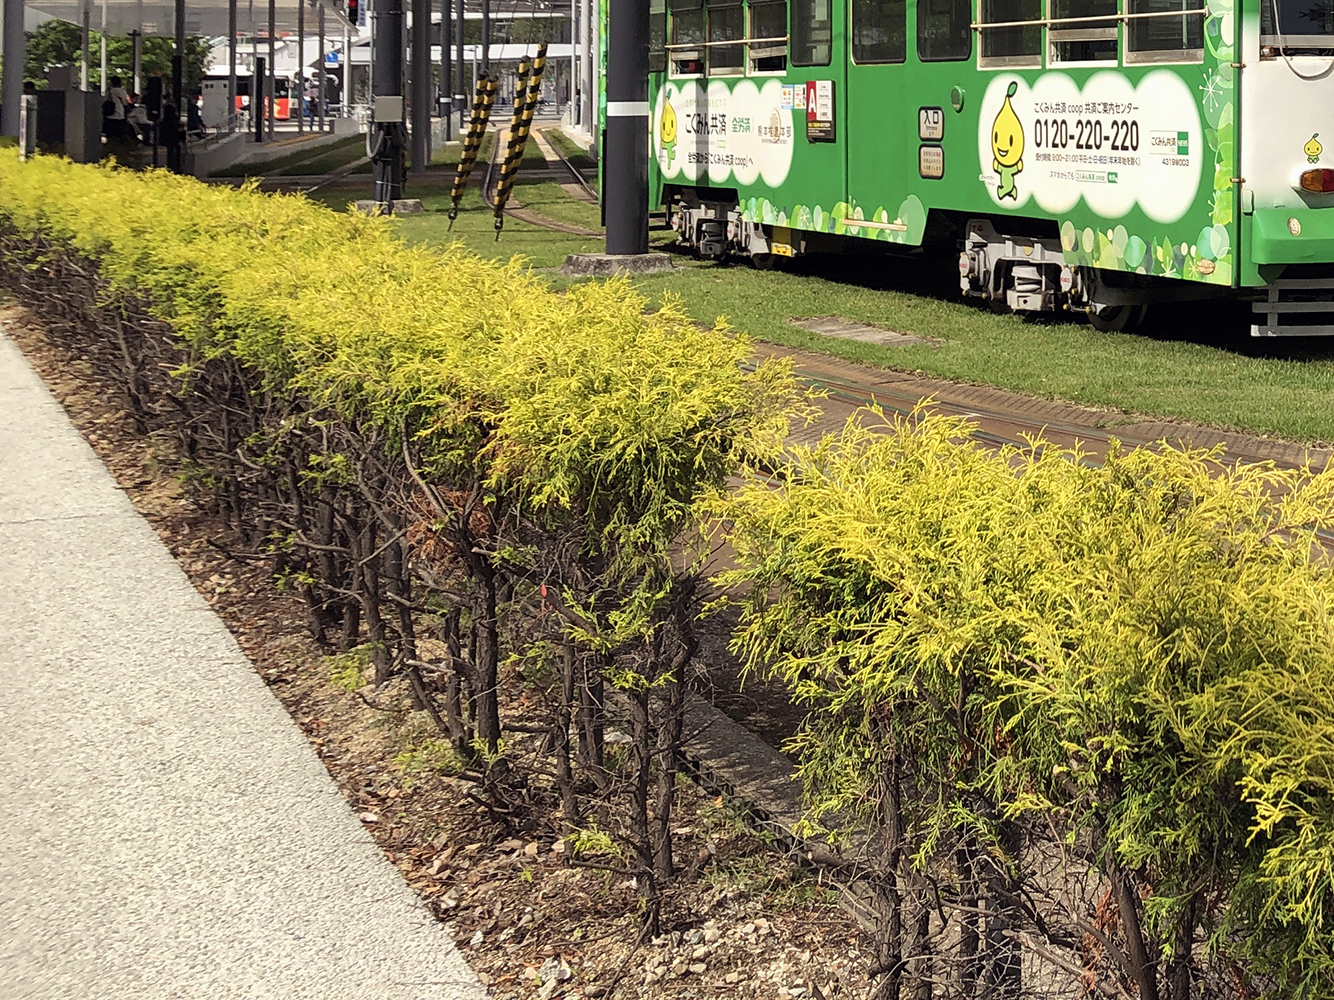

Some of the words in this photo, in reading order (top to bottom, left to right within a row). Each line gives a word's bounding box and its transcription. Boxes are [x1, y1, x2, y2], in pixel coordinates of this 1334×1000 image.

[808, 88, 817, 113] A
[1034, 102, 1067, 114] こくみん共済
[1068, 104, 1083, 116] coop
[1084, 103, 1139, 115] 共済ご案内センター
[685, 113, 727, 135] こくみん共済
[924, 110, 939, 125] 入口
[1034, 119, 1139, 152] 0120-220-220
